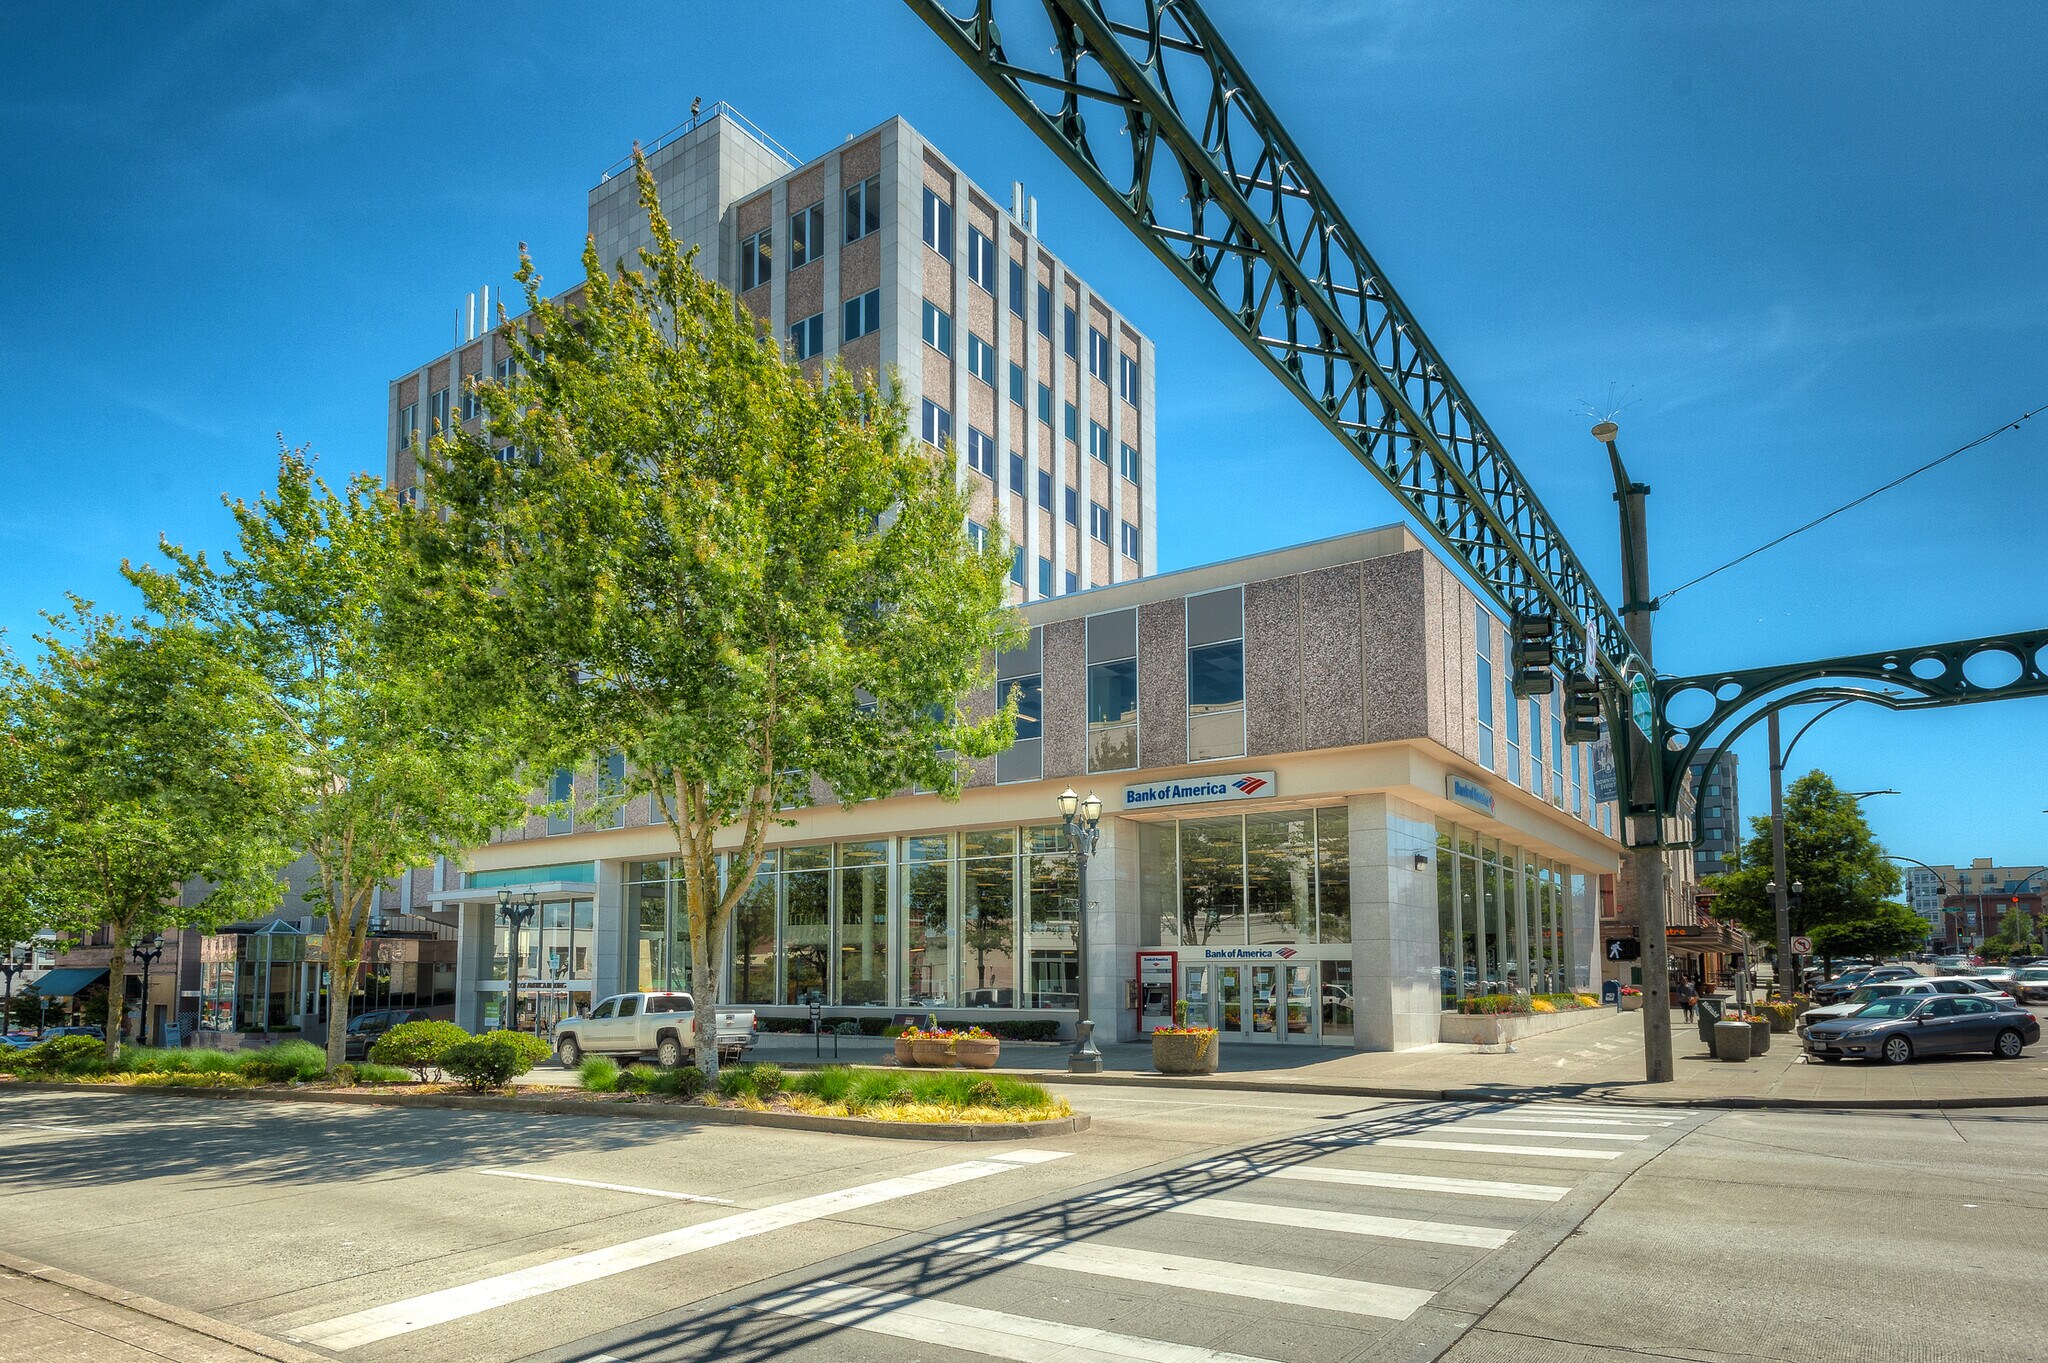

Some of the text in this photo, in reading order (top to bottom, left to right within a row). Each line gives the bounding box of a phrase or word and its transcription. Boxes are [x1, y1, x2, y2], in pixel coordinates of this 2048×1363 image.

[1127, 782, 1226, 803] Bank of America
[1205, 948, 1273, 958] Bank of America
